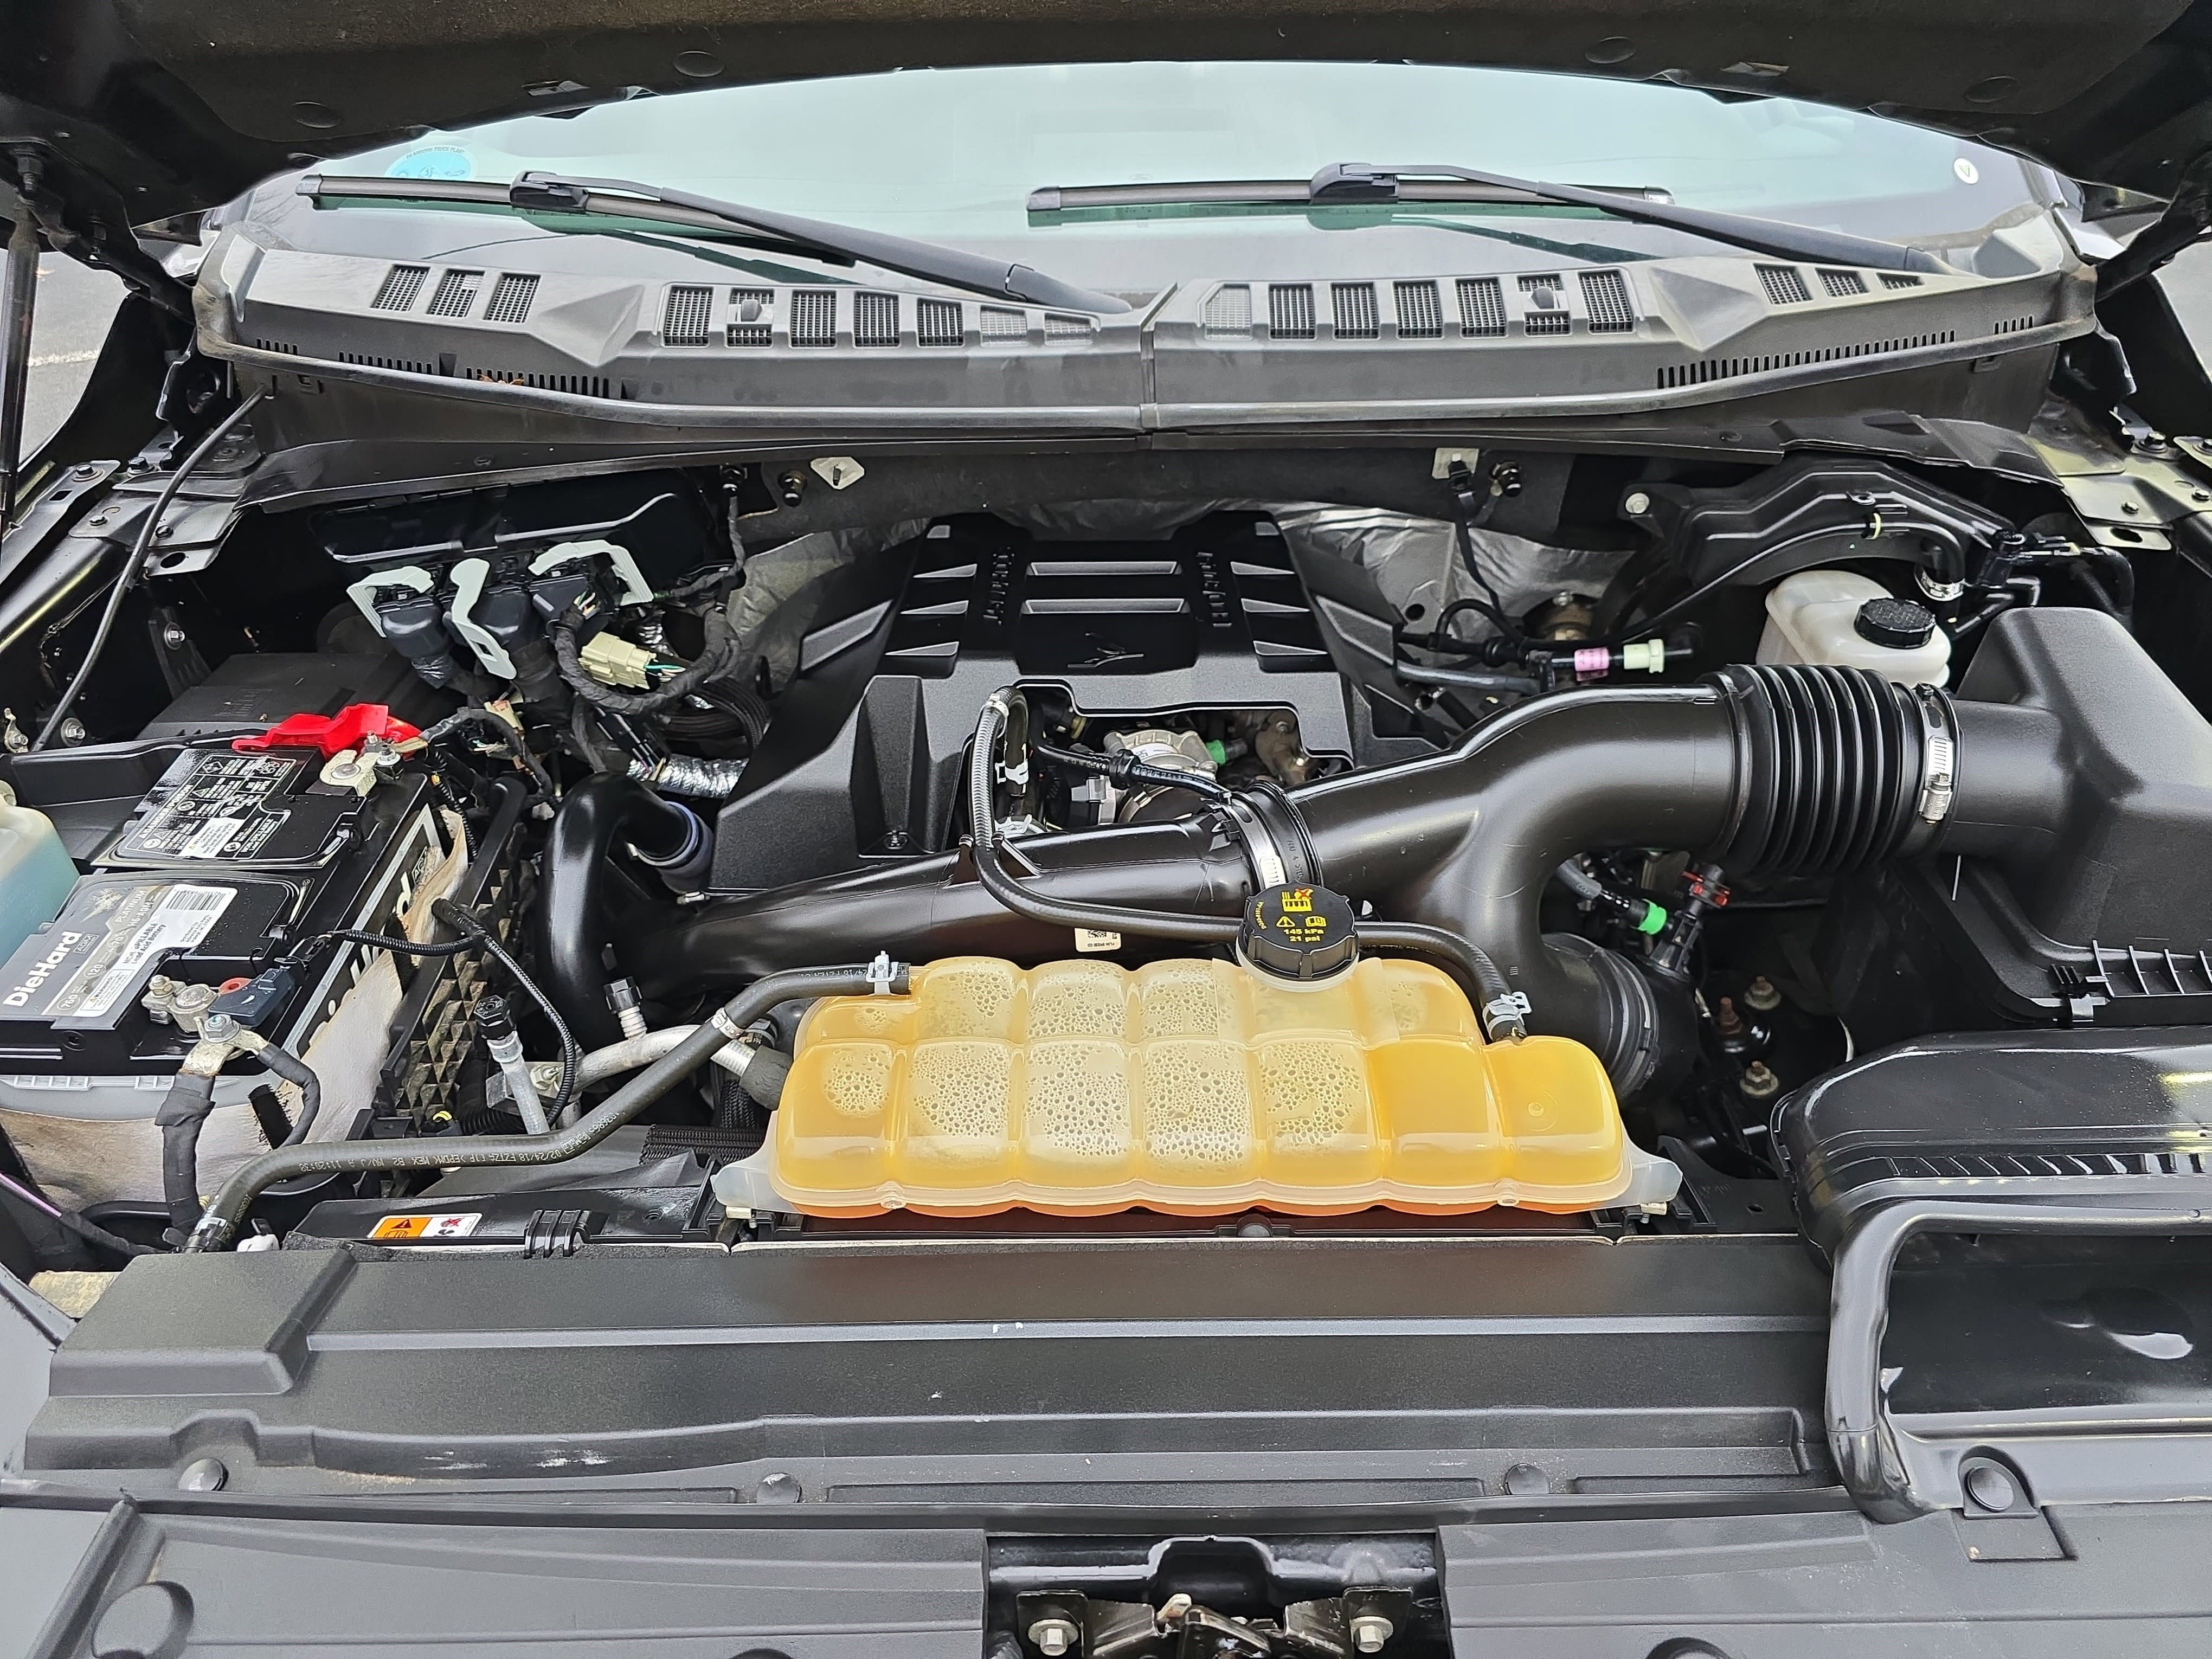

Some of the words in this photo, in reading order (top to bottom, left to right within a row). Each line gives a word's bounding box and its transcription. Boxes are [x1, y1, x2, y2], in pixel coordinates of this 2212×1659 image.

[114, 890, 147, 922] PLATINUM
[75, 935, 94, 951] AGM
[138, 941, 152, 951] Acid
[146, 924, 167, 941] Battery
[3, 931, 82, 1007] DieHard
[86, 964, 104, 975] 120
[60, 994, 79, 1007] 760
[392, 1157, 406, 1166] B2
[411, 1156, 430, 1165] MEX
[519, 1150, 563, 1161] 02/24/18
